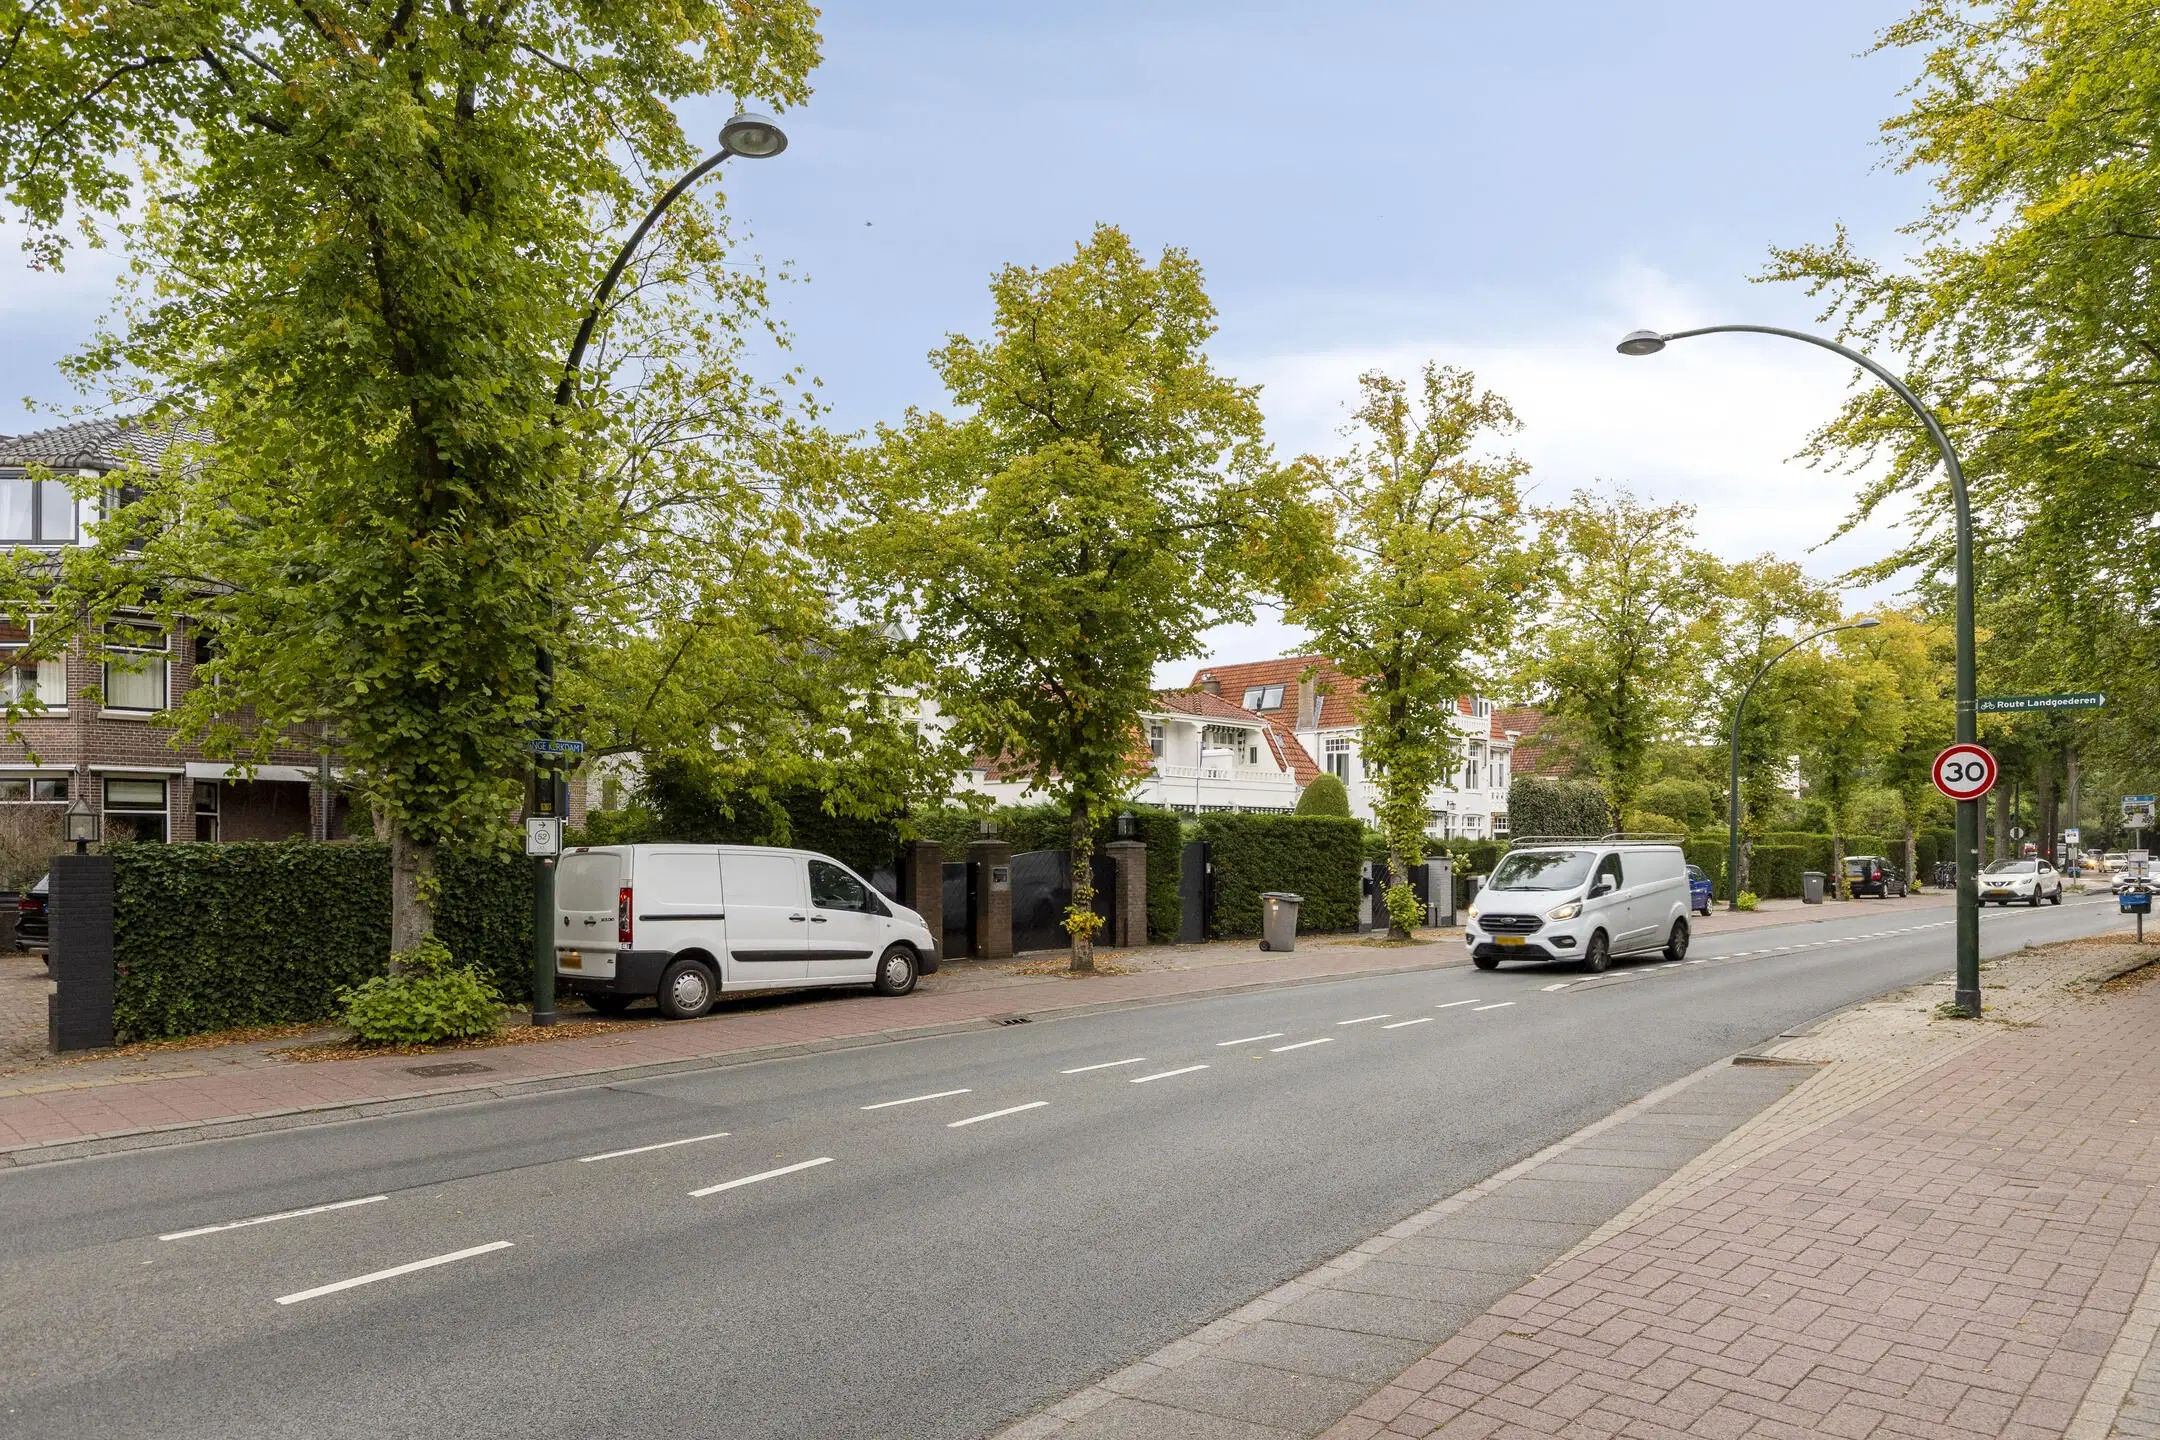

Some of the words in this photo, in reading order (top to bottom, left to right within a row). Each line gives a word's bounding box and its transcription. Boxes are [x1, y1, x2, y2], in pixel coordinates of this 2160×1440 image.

[1997, 700, 2025, 709] Route
[2027, 697, 2097, 708] Landgoederen
[1945, 761, 1985, 783] 30
